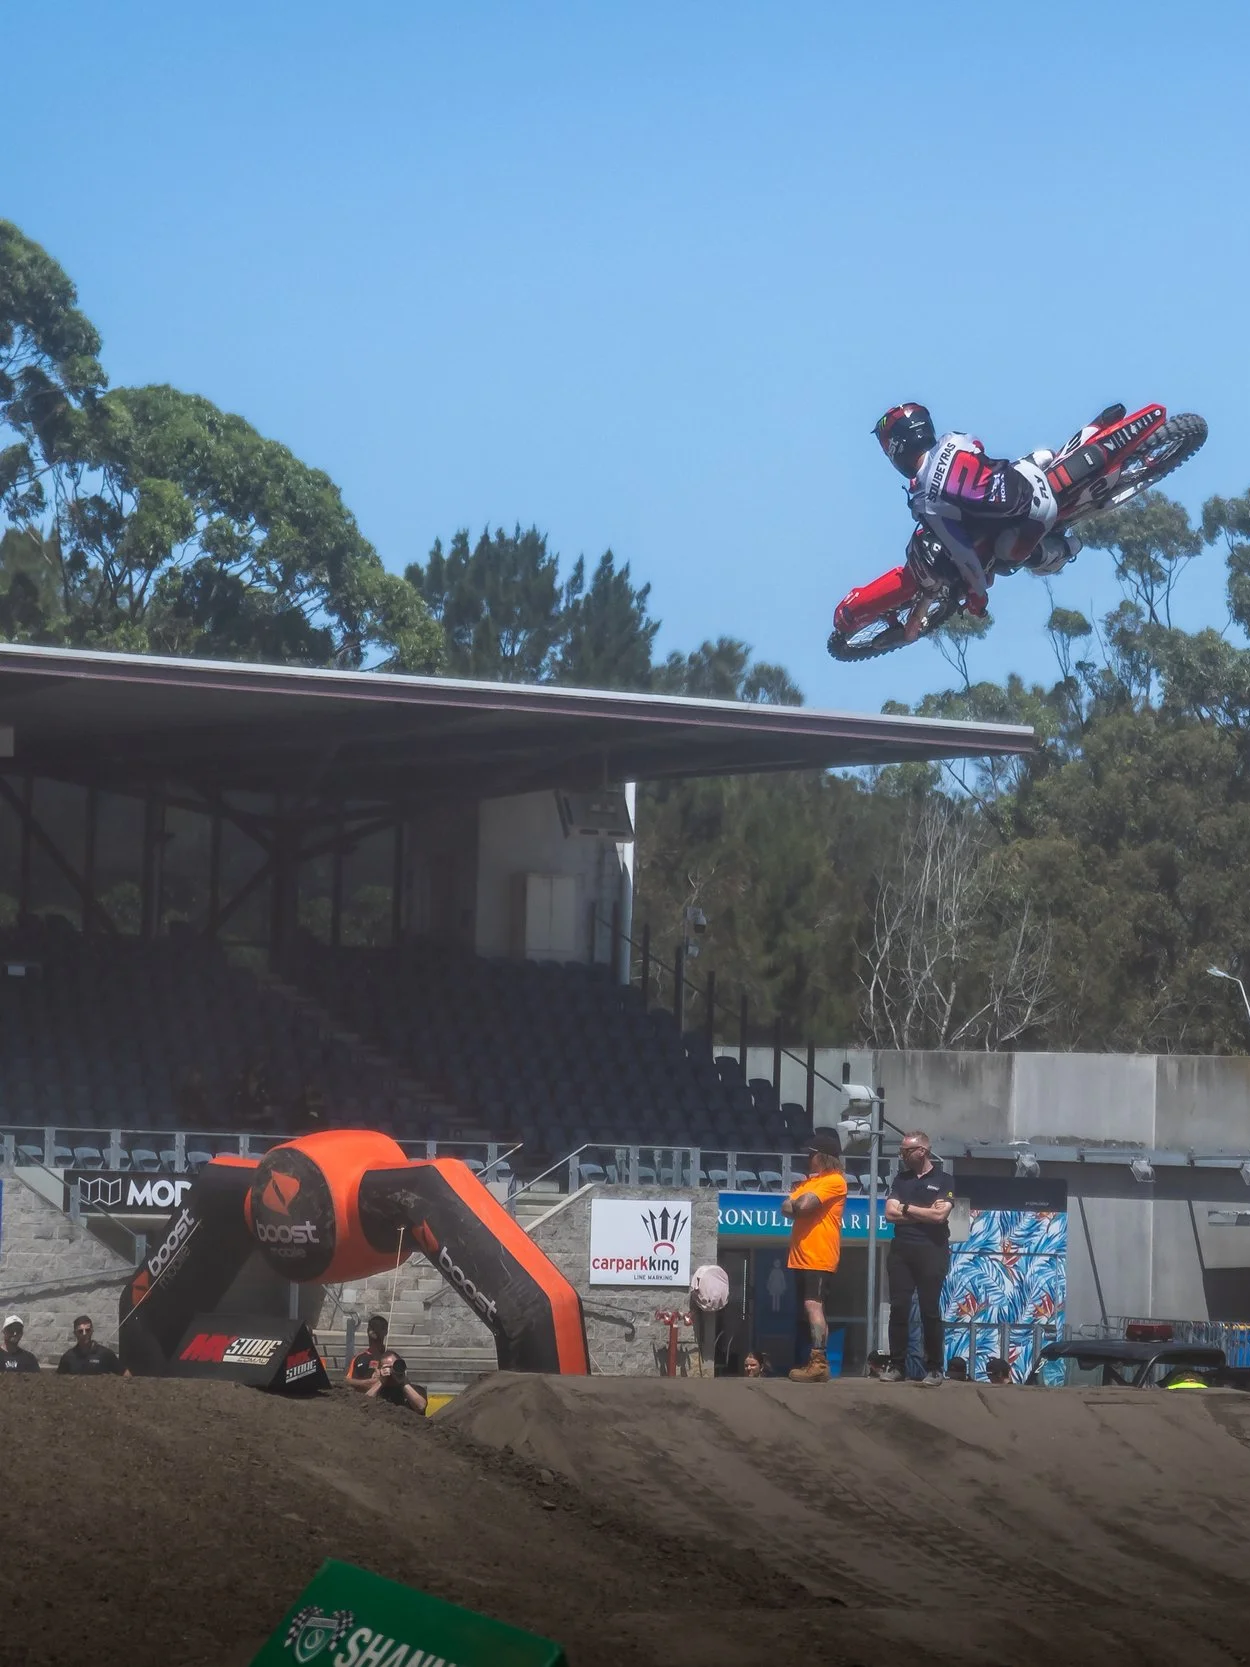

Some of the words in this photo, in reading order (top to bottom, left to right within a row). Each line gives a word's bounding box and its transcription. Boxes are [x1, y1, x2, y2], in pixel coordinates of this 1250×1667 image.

[928, 442, 956, 503] SOUBEYRAS
[148, 1208, 195, 1277] boost
[256, 1219, 320, 1244] boost
[717, 1209, 793, 1227] RONULL
[439, 1246, 497, 1323] boost
[334, 1627, 457, 1667] SHA
